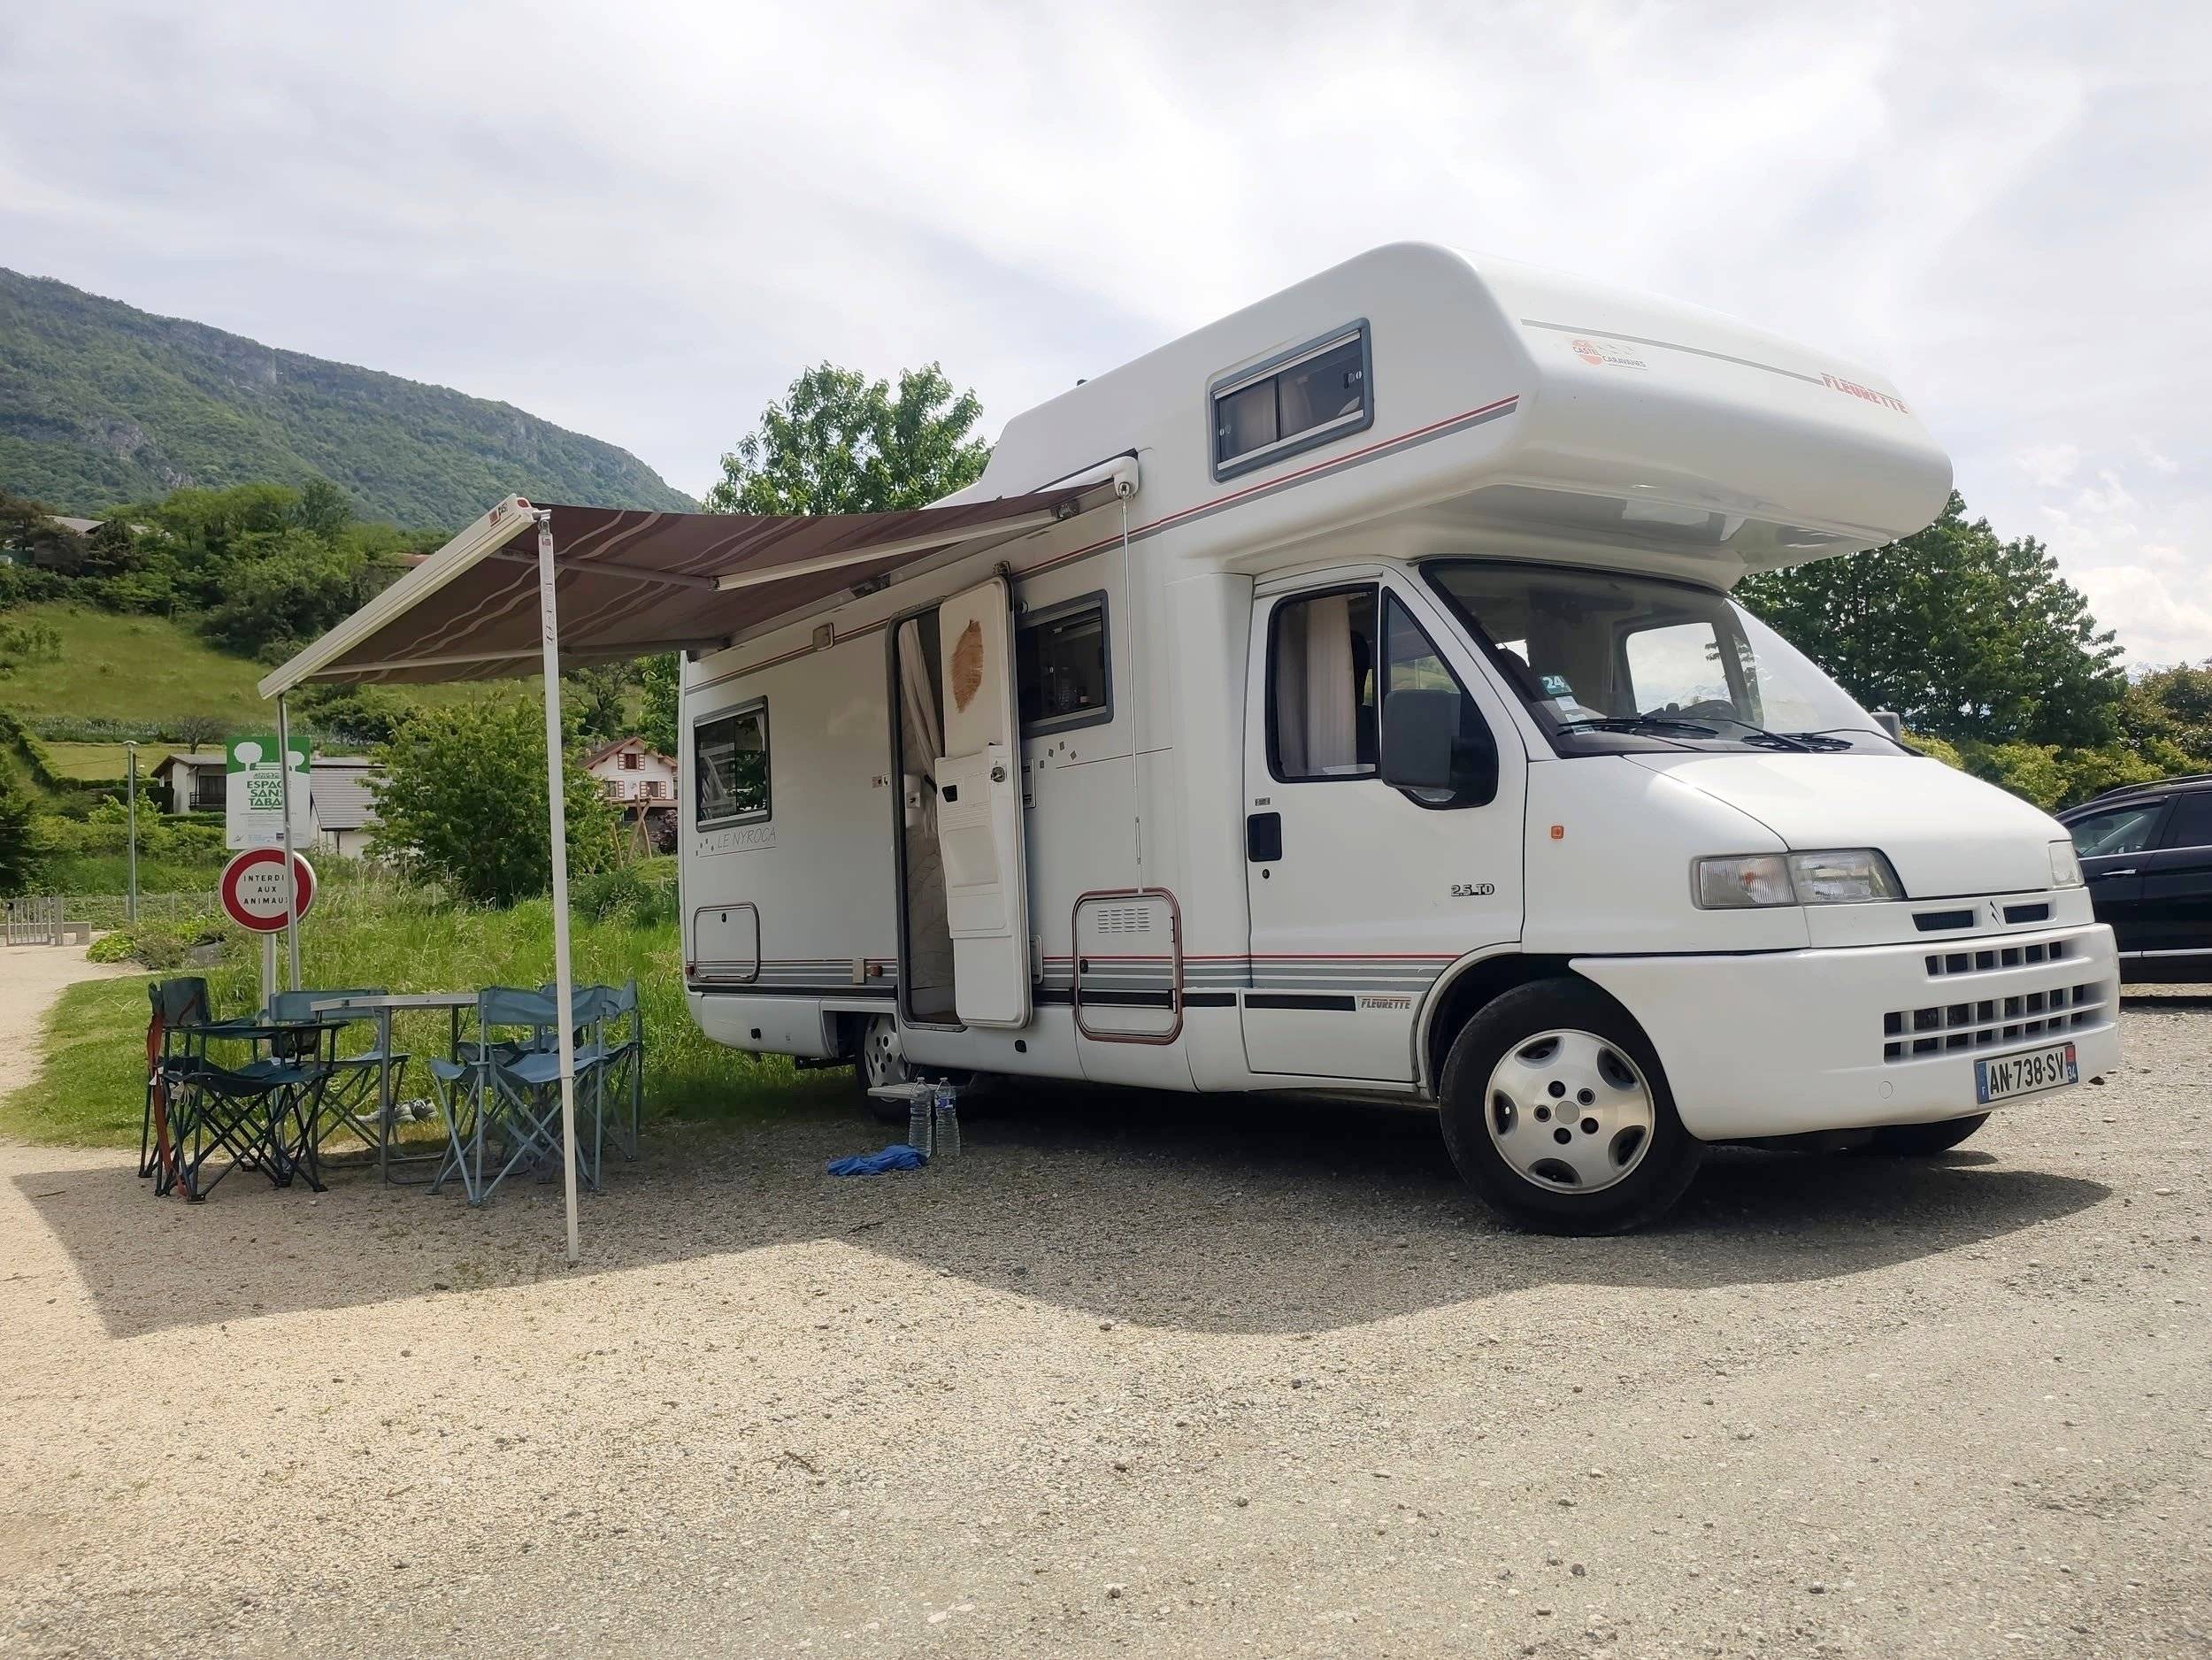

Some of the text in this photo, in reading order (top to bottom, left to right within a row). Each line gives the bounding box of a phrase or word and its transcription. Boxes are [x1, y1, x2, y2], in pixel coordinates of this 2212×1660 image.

[1823, 375, 1909, 414] FLEURETTE
[1542, 675, 1565, 689] 24
[250, 788, 282, 797] SAN
[249, 797, 282, 806] TABA
[1476, 883, 1495, 895] TD
[1361, 999, 1411, 1010] FLEURETTE
[1990, 1052, 2063, 1095] AN-738-SV
[2067, 1065, 2077, 1080] 34
